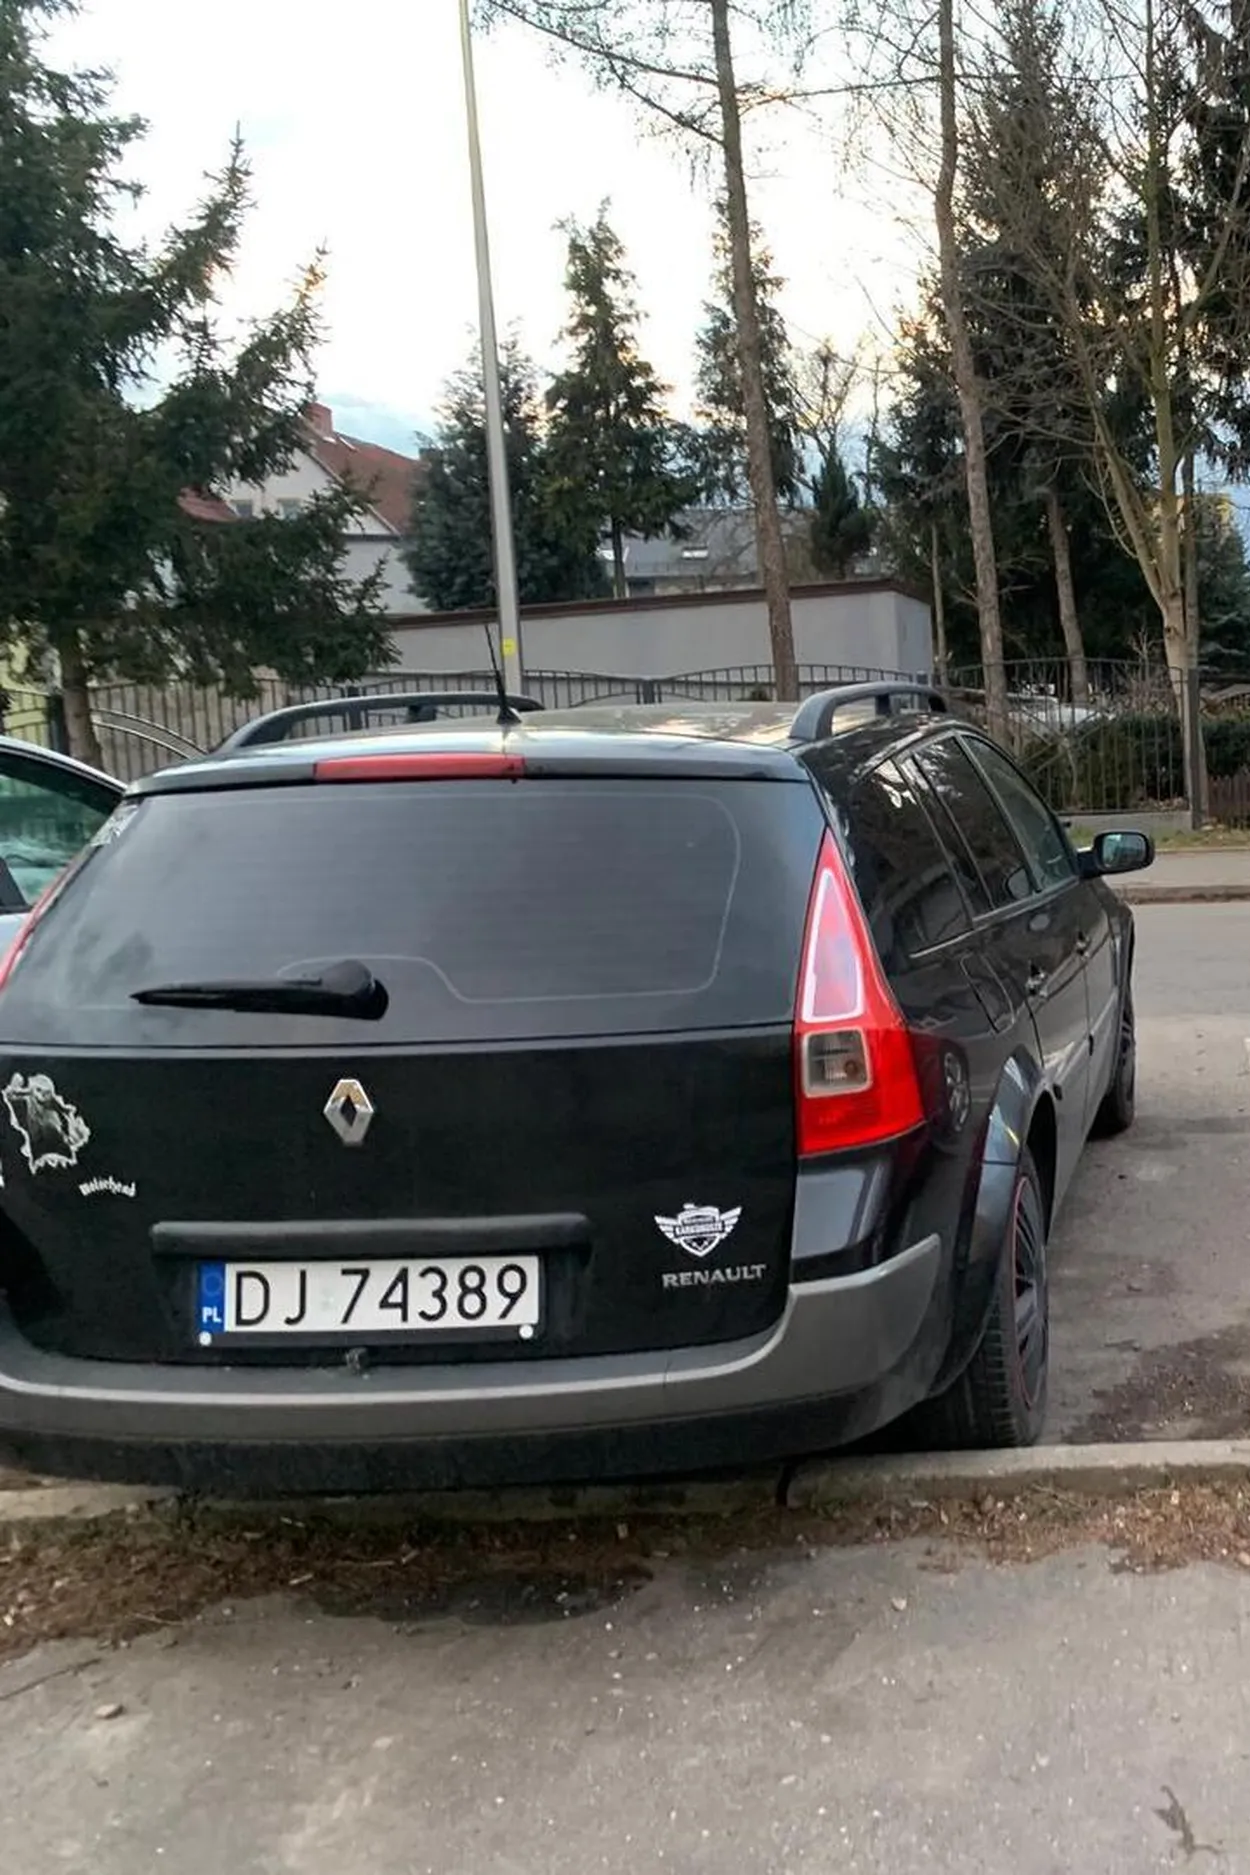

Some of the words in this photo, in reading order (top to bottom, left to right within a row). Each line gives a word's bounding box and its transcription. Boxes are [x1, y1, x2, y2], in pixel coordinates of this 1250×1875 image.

[662, 1264, 767, 1288] RENAULT
[235, 1268, 307, 1327] DJ
[340, 1263, 528, 1325] 74389
[203, 1307, 221, 1323] PL
